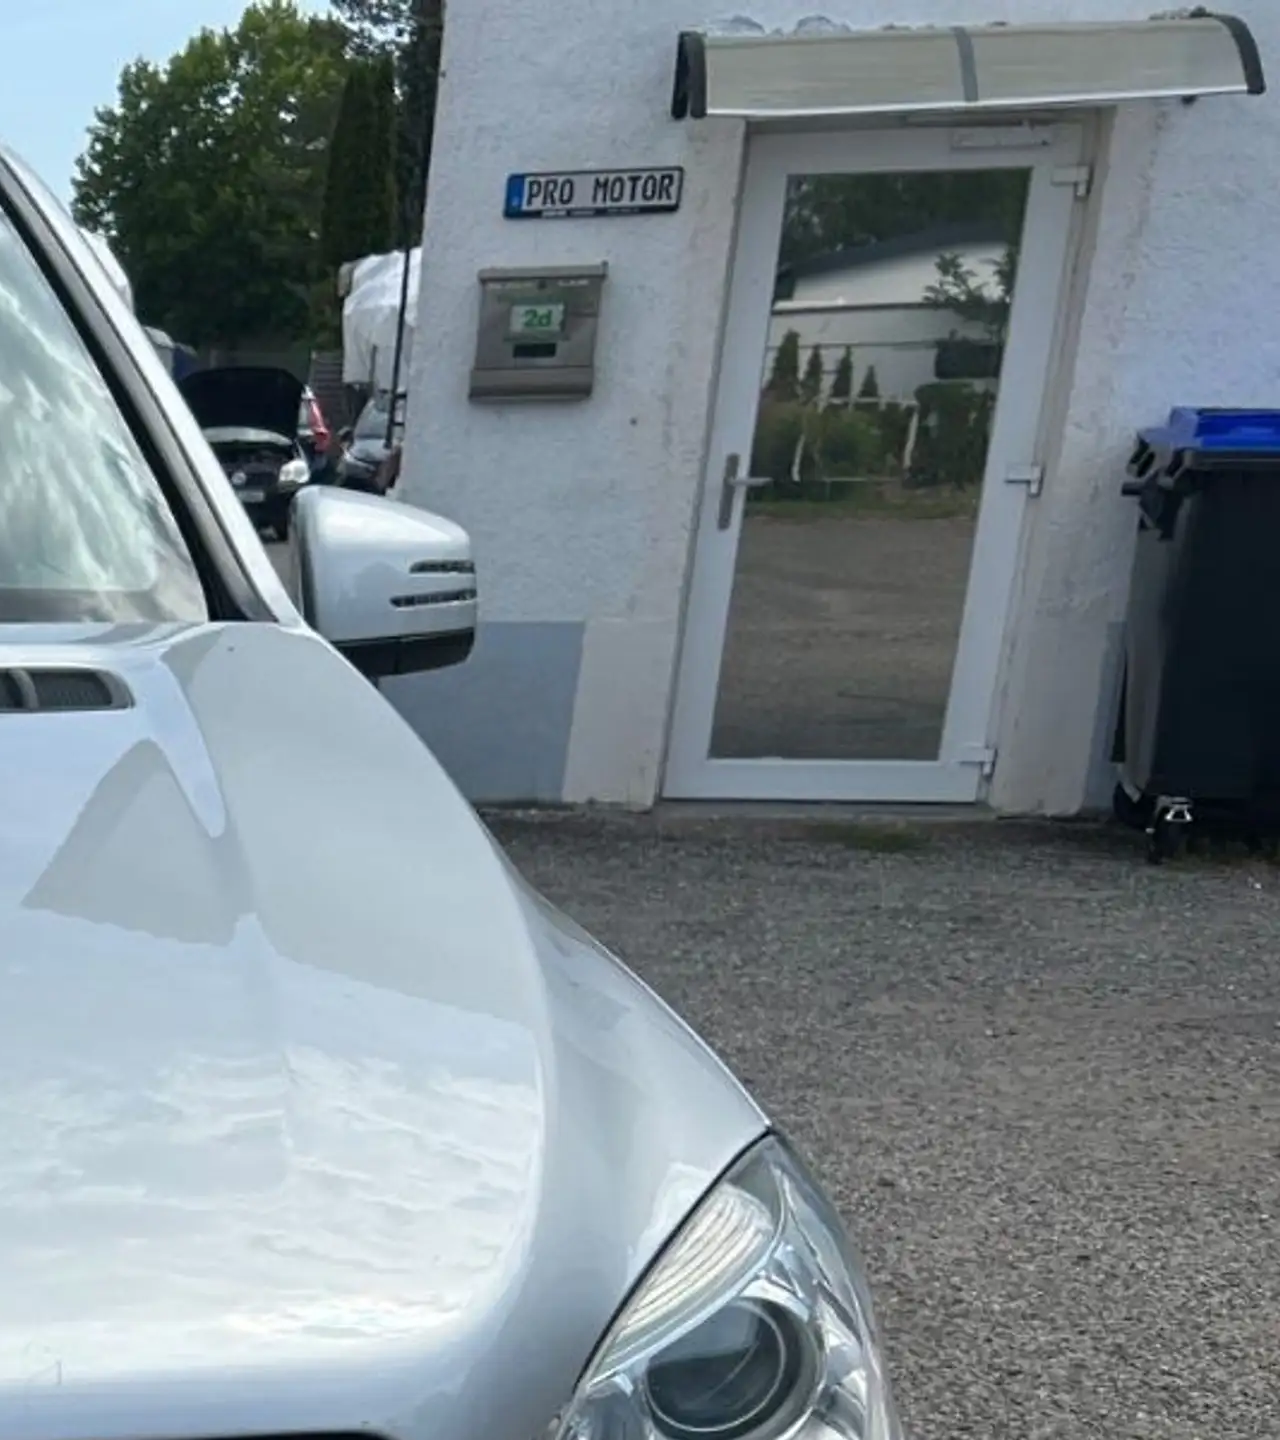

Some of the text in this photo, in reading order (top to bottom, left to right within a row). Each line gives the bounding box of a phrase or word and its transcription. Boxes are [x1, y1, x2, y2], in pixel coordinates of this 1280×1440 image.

[525, 173, 675, 208] PRO MOTOR
[523, 308, 553, 328] 2d
